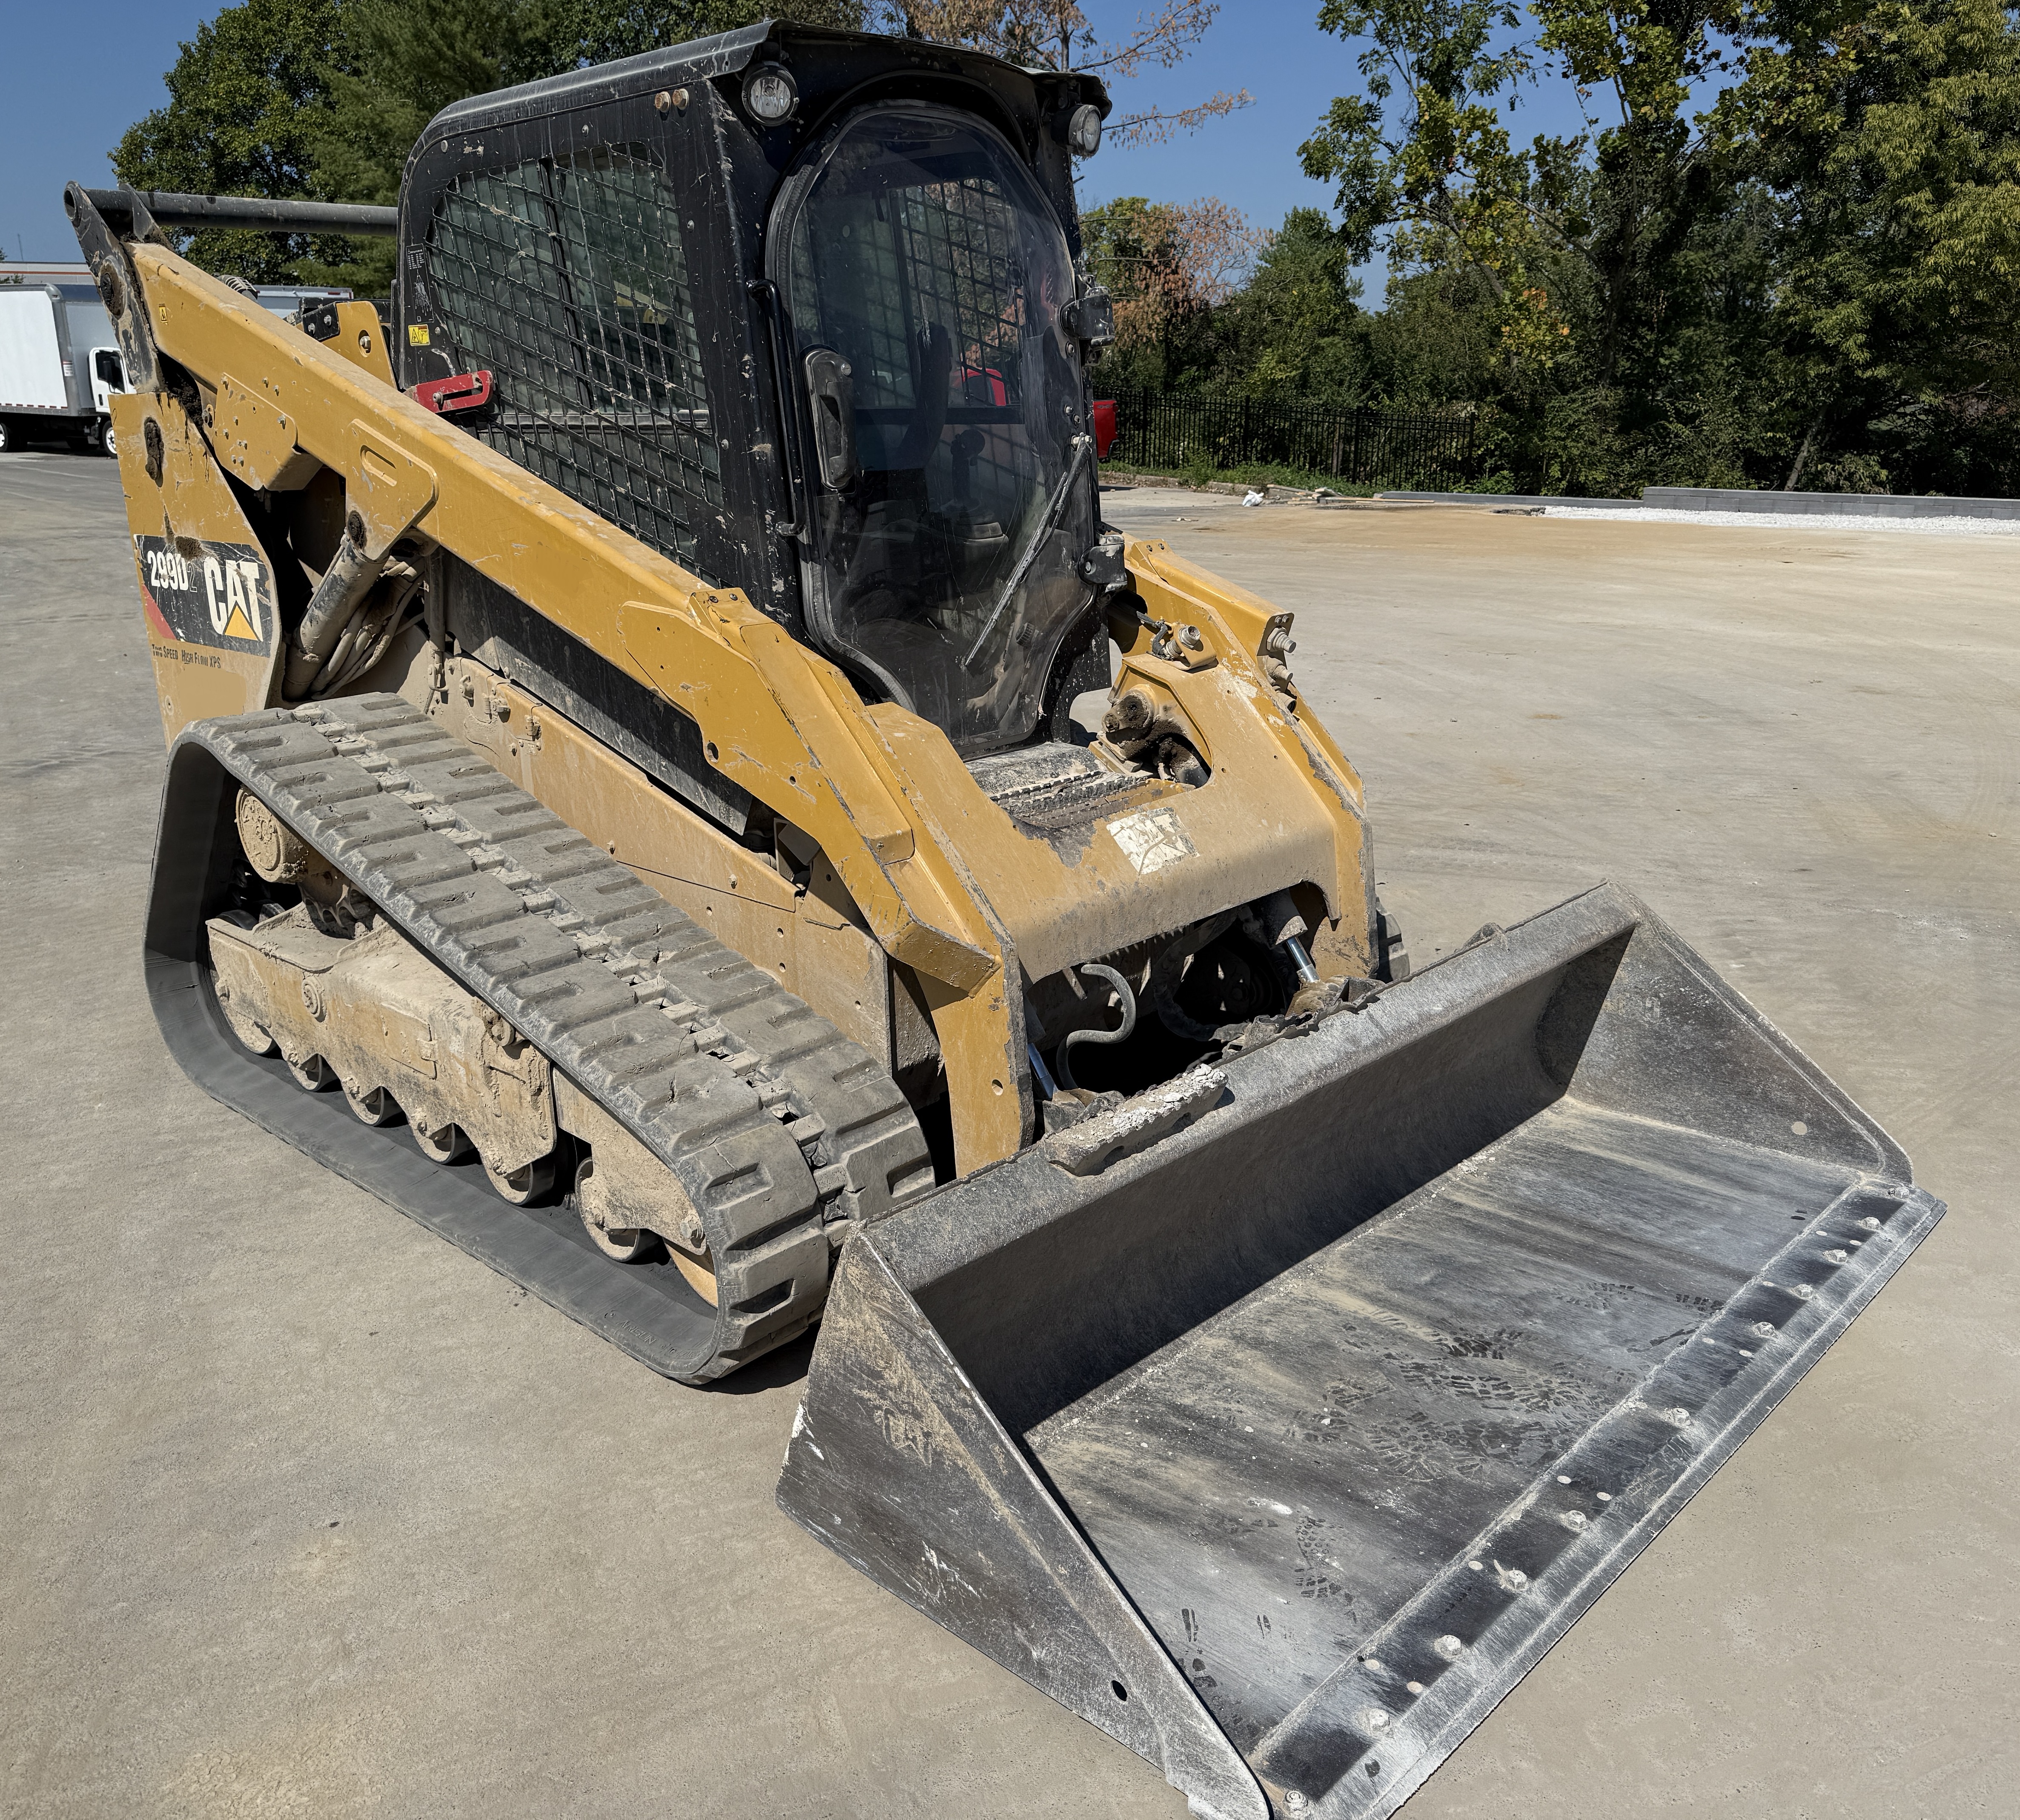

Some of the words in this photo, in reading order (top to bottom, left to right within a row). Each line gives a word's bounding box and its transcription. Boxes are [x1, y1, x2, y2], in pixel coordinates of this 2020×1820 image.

[203, 556, 264, 642] CAT
[163, 645, 178, 660] SPEED
[181, 649, 193, 663] HIGH
[194, 652, 208, 666] FLOW
[209, 655, 221, 668] XPS
